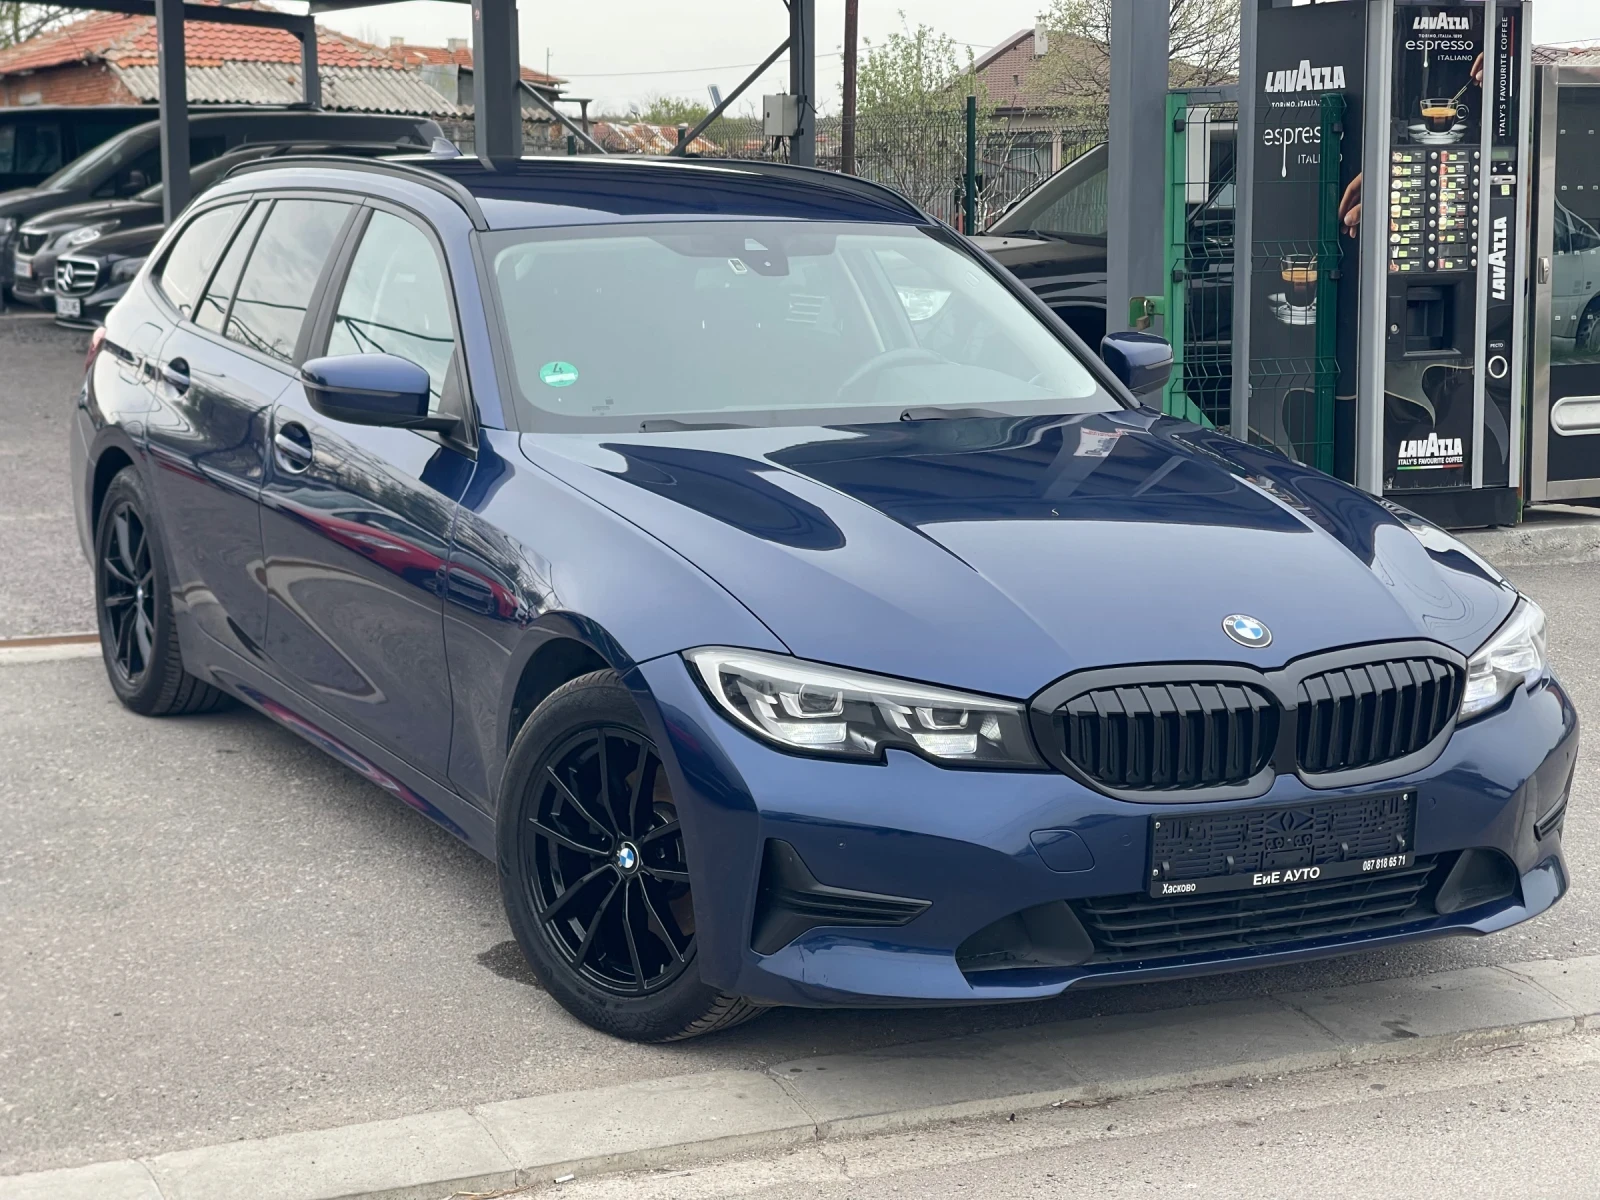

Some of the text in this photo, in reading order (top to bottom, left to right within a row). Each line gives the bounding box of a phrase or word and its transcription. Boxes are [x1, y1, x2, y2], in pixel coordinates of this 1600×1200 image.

[1412, 12, 1470, 30] LAVAZZA
[1500, 16, 1508, 50] COFFEE
[1405, 40, 1474, 57] espresso
[1264, 60, 1346, 92] LAVAZZA
[1499, 53, 1507, 101] FAVOURITE
[1488, 216, 1507, 301] LAVAZZA
[1398, 432, 1463, 458] LAVAZZA
[1398, 458, 1418, 466] ITALY'S
[1418, 457, 1445, 465] FAVOURITE
[1362, 854, 1406, 871] 087 818 65 71
[1252, 866, 1321, 886] ЕиЕ АУТО
[1162, 882, 1197, 894] Хасково
